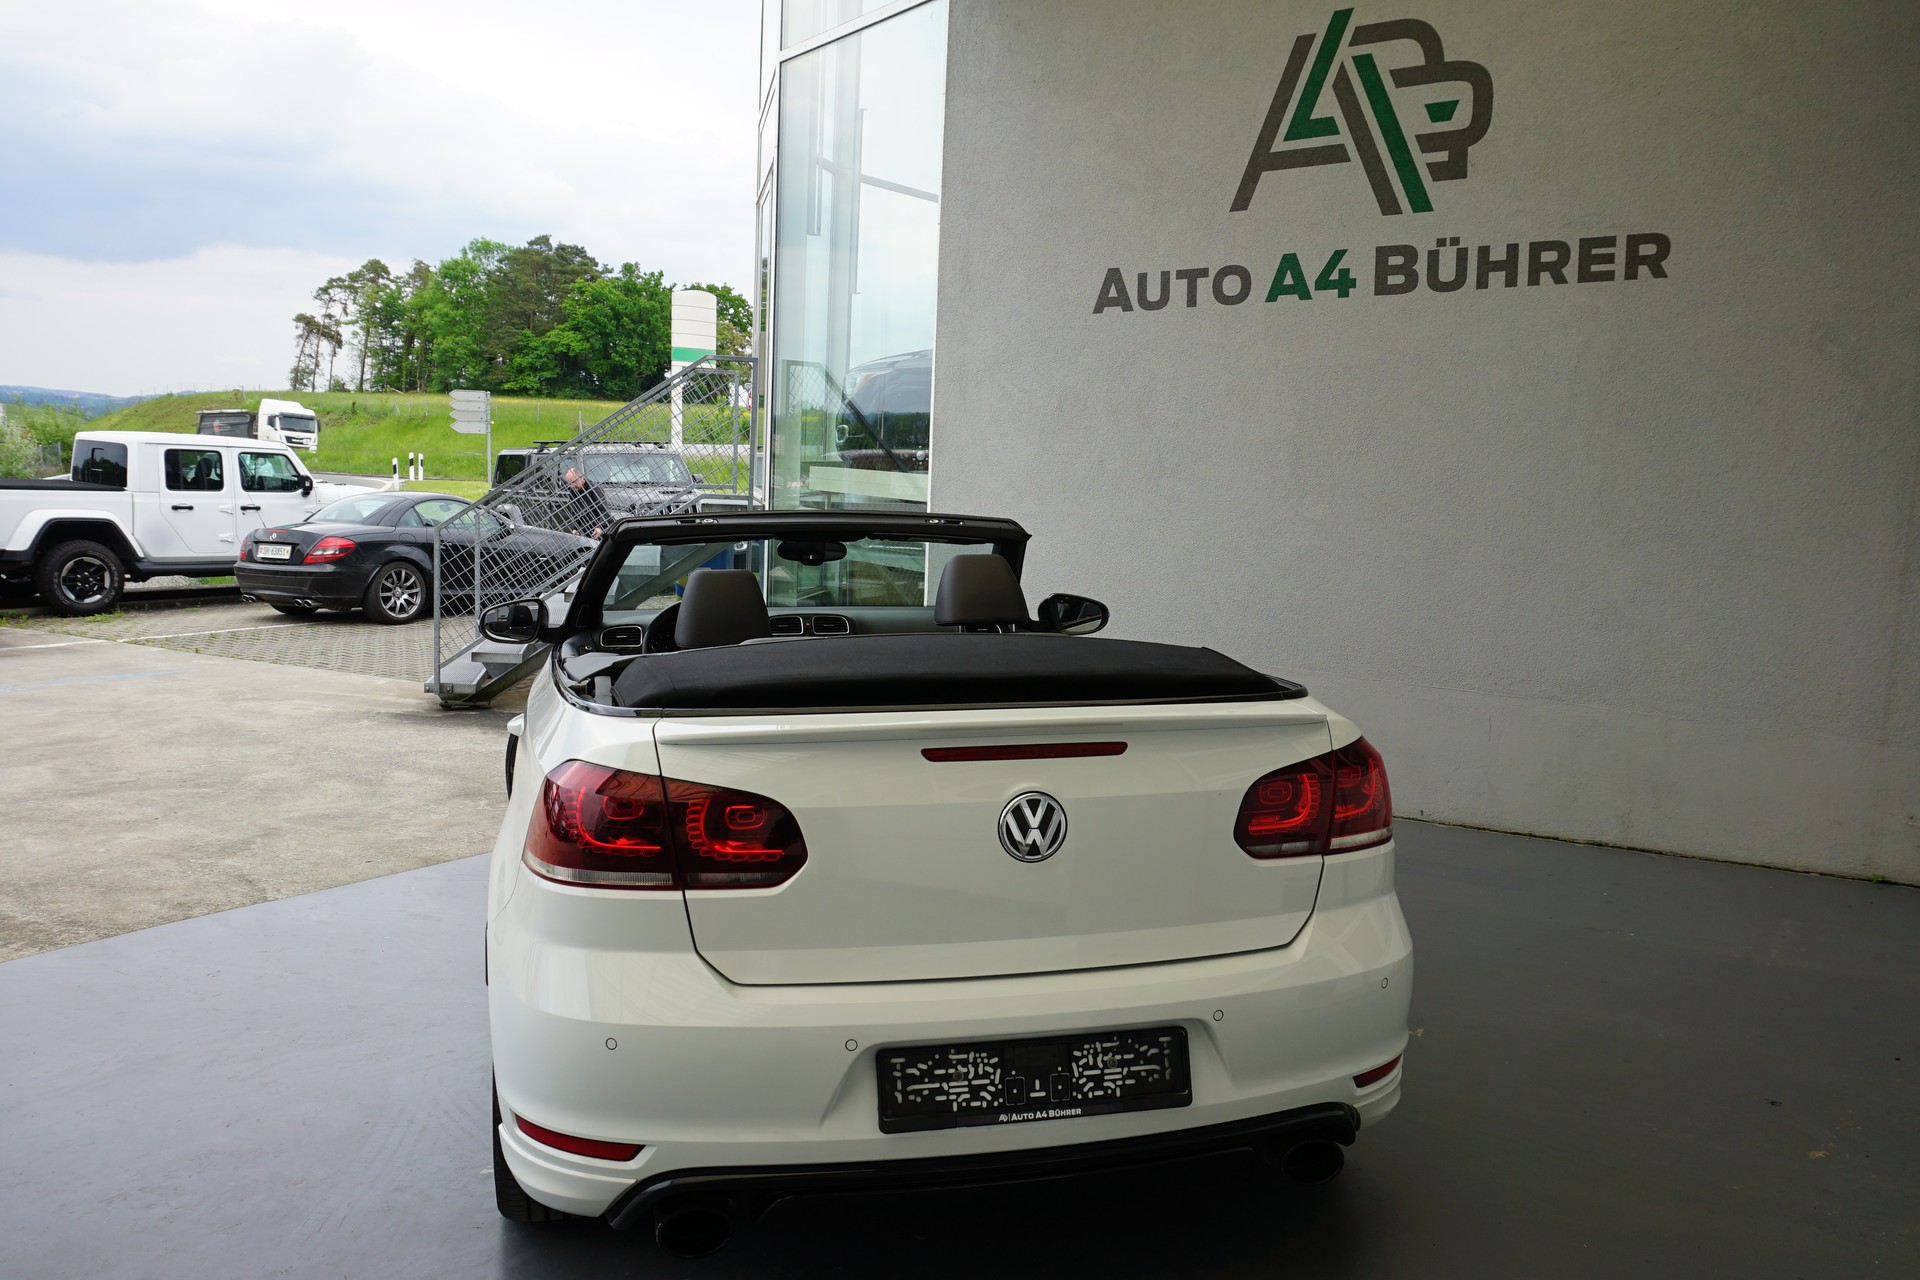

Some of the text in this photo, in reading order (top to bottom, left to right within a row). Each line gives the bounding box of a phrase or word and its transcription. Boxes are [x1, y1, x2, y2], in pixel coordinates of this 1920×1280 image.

[1092, 231, 1672, 314] AUTO A4 BÜHRER
[1003, 796, 1064, 859] VW
[1011, 1112, 1034, 1121] AUTO
[1035, 1110, 1047, 1119] A4
[1048, 1108, 1082, 1118] BÜHRER
